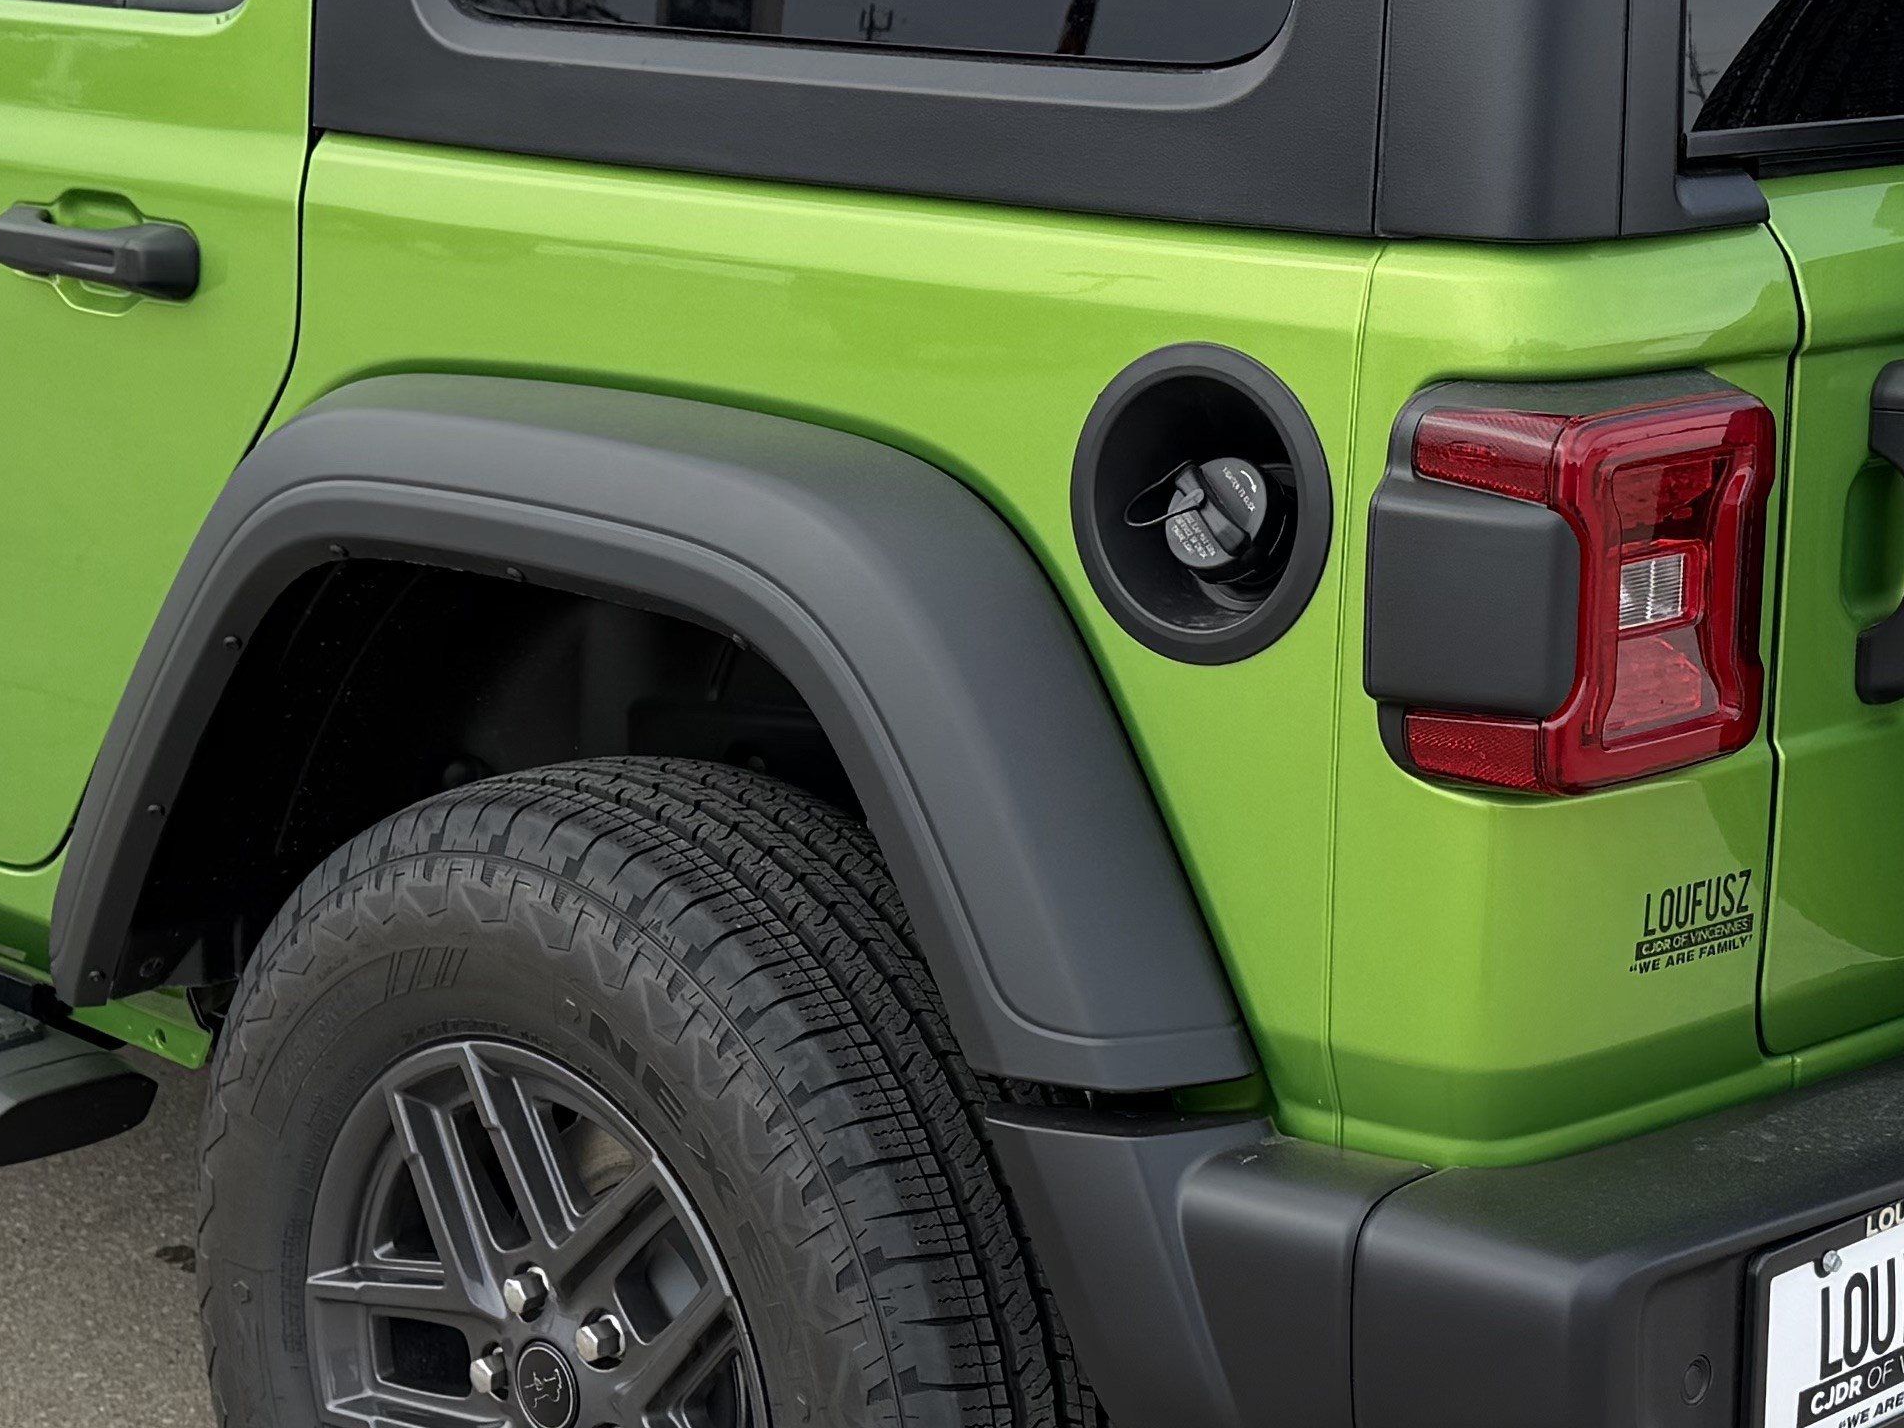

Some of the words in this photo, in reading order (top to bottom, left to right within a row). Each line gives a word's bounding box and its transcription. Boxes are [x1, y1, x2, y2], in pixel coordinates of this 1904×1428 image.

[1664, 949, 1695, 968] ARE
[1810, 1374, 1863, 1416] CJDR
[1867, 1363, 1894, 1390] OF
[1872, 1392, 1904, 1420] ARE
